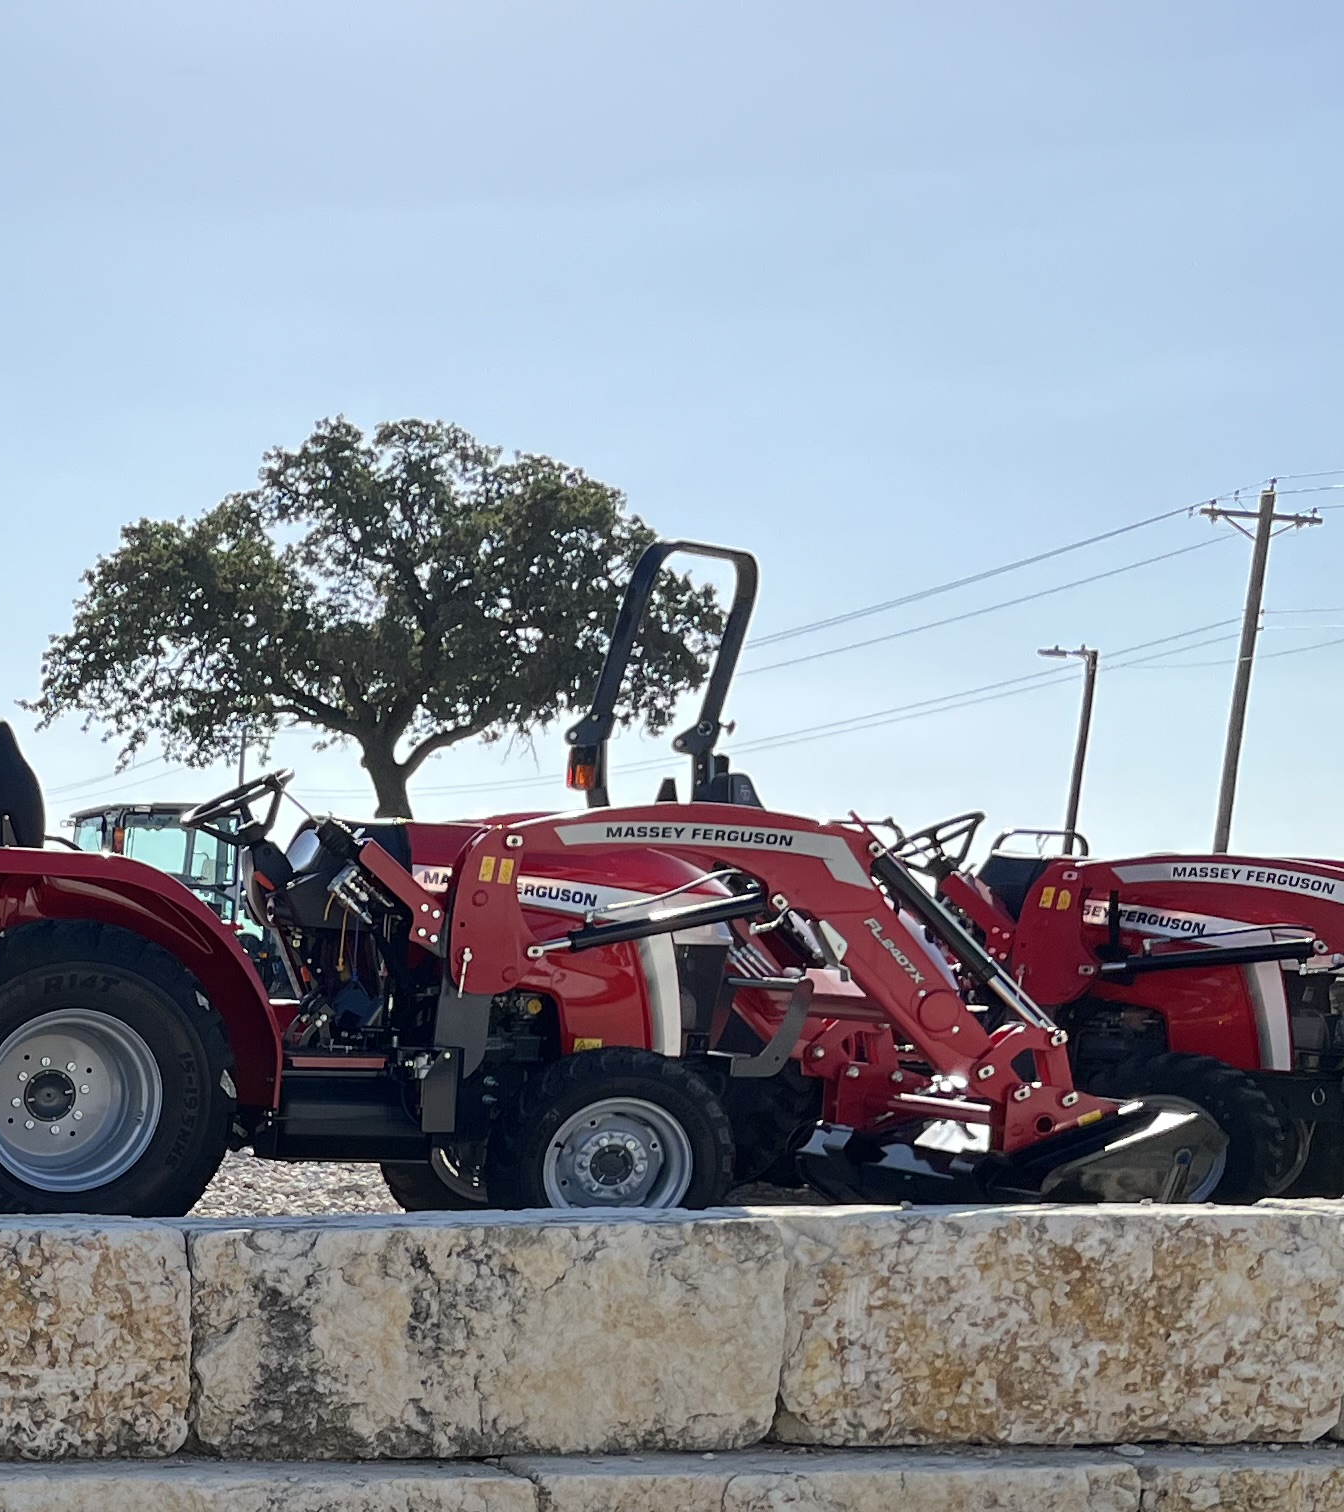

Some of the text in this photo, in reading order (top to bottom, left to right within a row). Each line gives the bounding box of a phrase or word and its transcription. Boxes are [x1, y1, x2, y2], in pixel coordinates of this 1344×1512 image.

[605, 826, 794, 847] MASSEY FERGUSON
[1172, 866, 1336, 895] MASSEY FERGUSON
[516, 882, 598, 908] ERGUSON
[1119, 909, 1207, 936] FERGUSON
